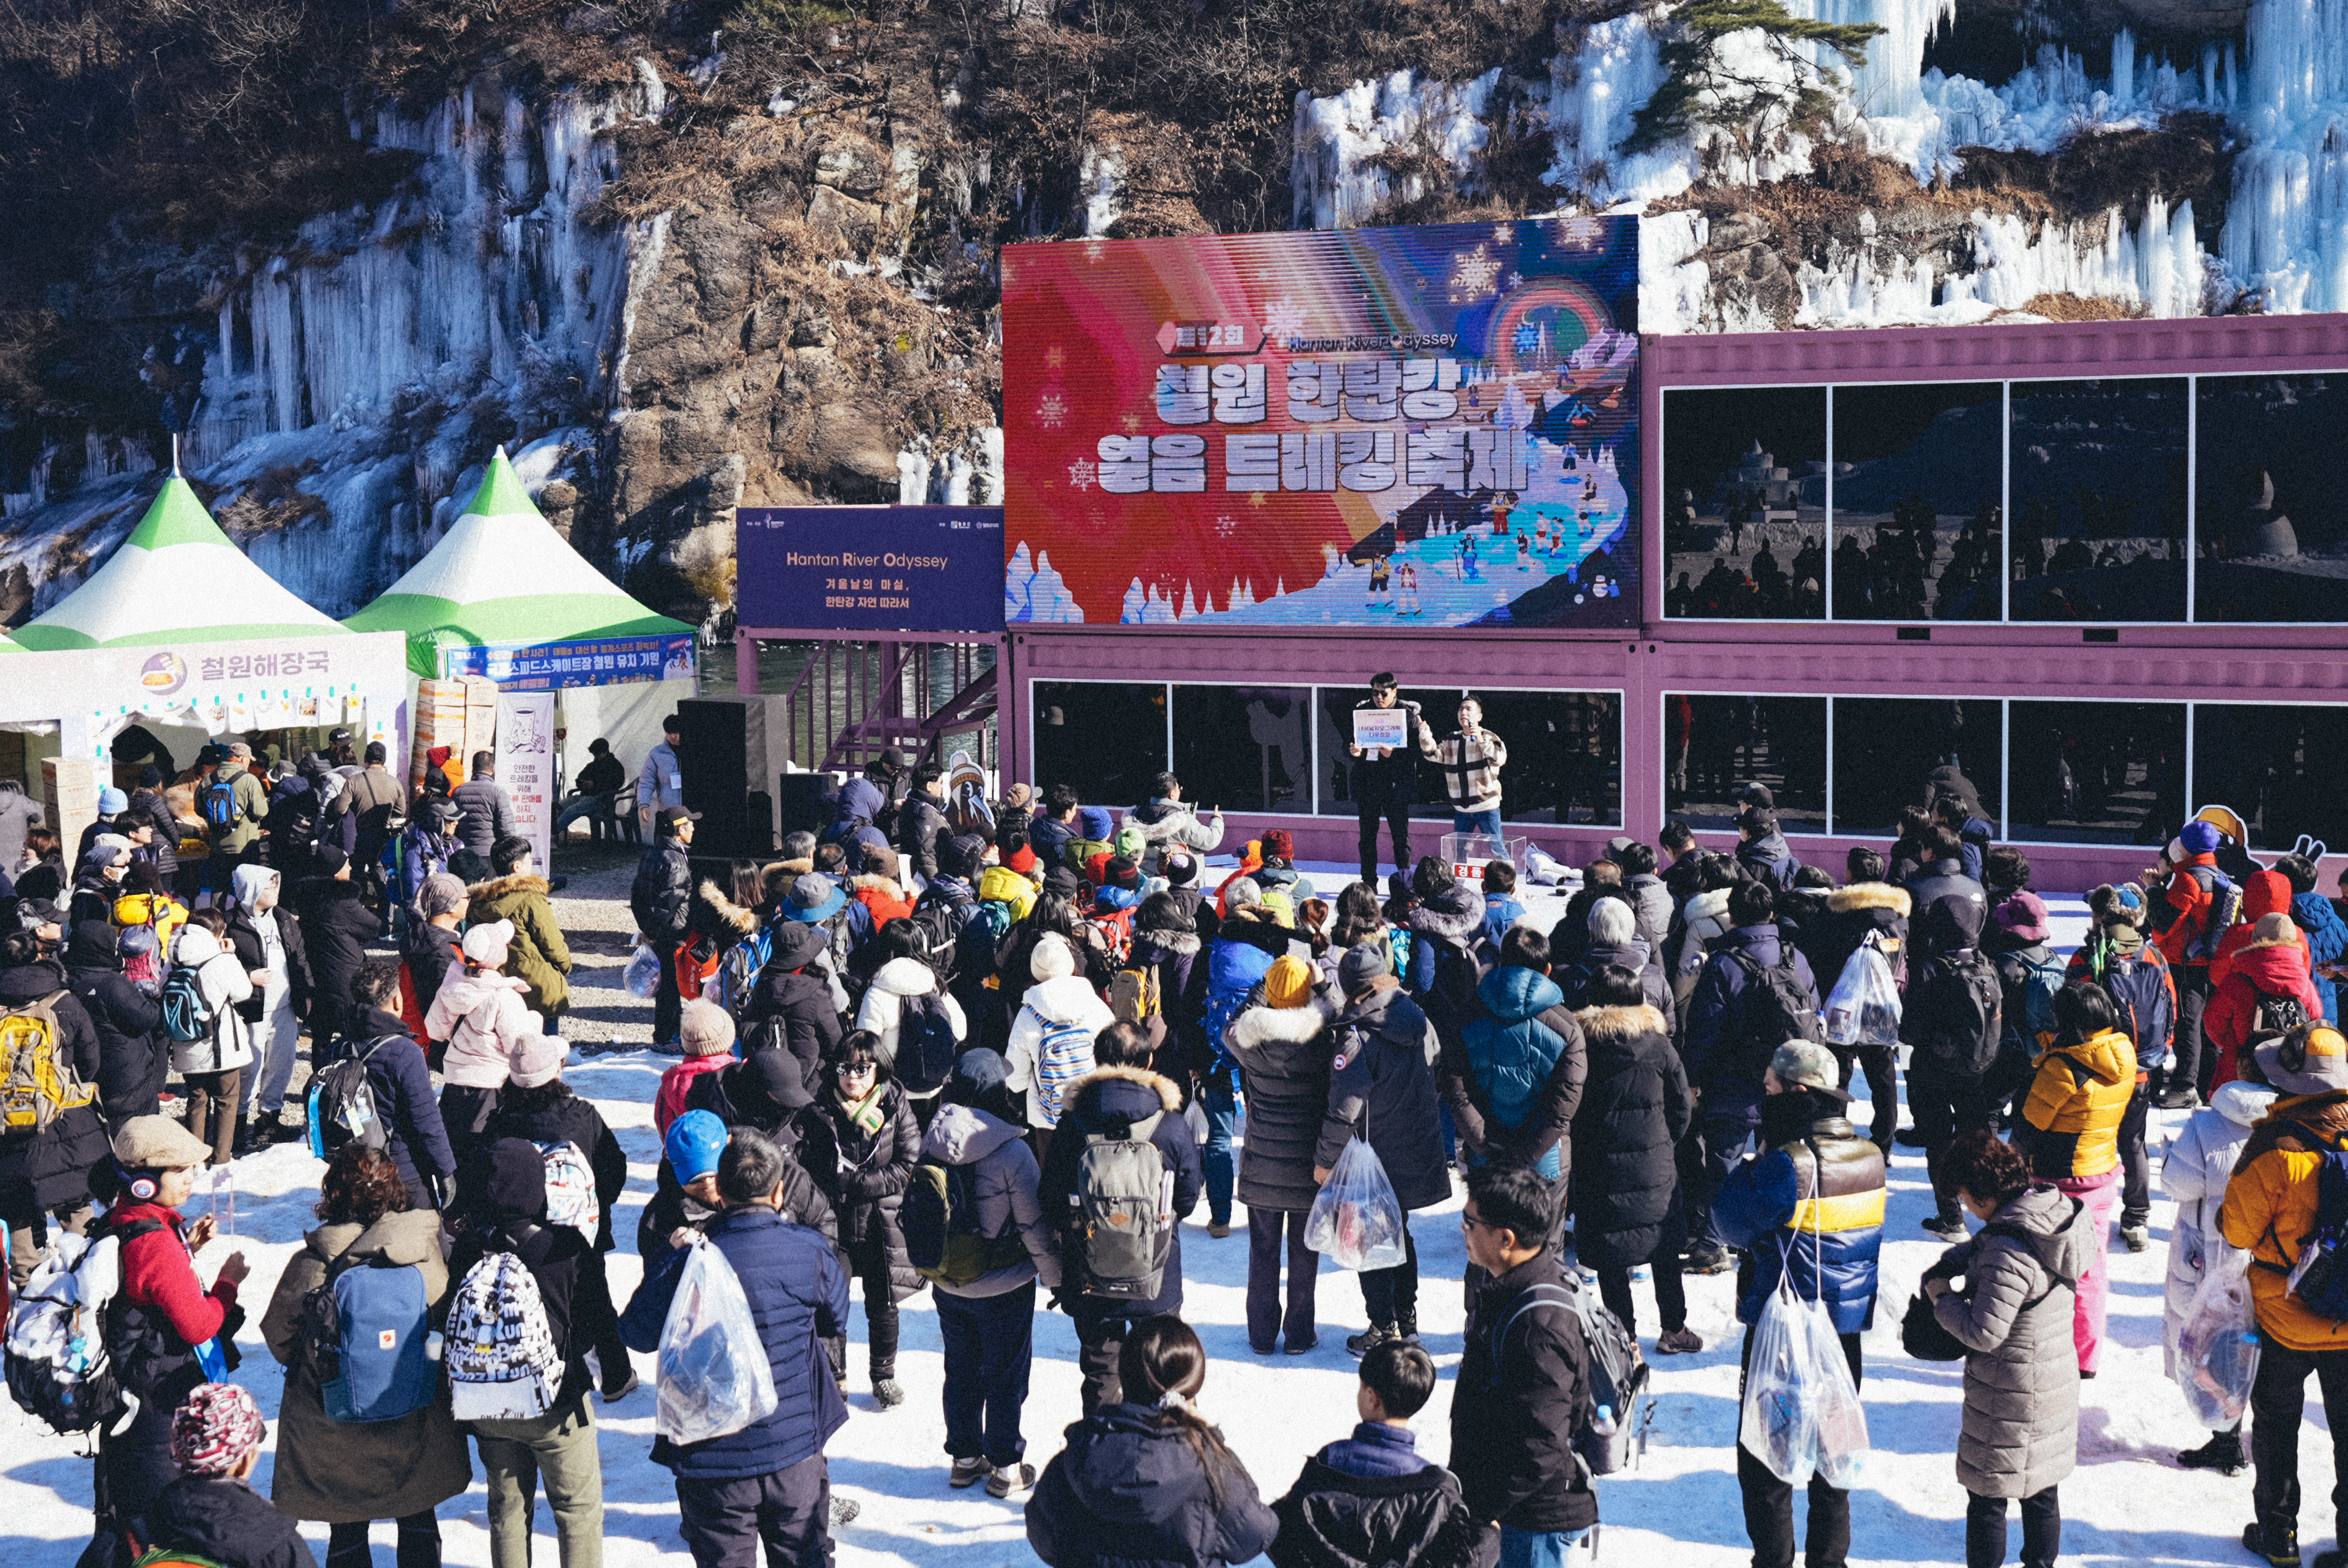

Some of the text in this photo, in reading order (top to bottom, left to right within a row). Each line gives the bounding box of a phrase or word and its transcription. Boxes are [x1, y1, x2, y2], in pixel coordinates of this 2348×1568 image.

[1289, 332, 1459, 352] Hantan River Odyssey
[1156, 358, 1462, 425] 철원 한탄강
[1097, 434, 1208, 493] 얼음
[786, 552, 949, 571] Hantan River Odyssey
[825, 596, 910, 608] 한탄강 자연 따라서
[201, 651, 329, 681] 철원해장국
[594, 655, 615, 670] 철원
[617, 653, 637, 668] 유치
[640, 652, 660, 667] 기원
[514, 765, 535, 773] 안전한
[510, 775, 538, 783] 트레킹을
[517, 785, 531, 793] 위해
[522, 795, 542, 803] 판매를
[516, 804, 531, 813] 하지
[1458, 865, 1482, 878] 경품
